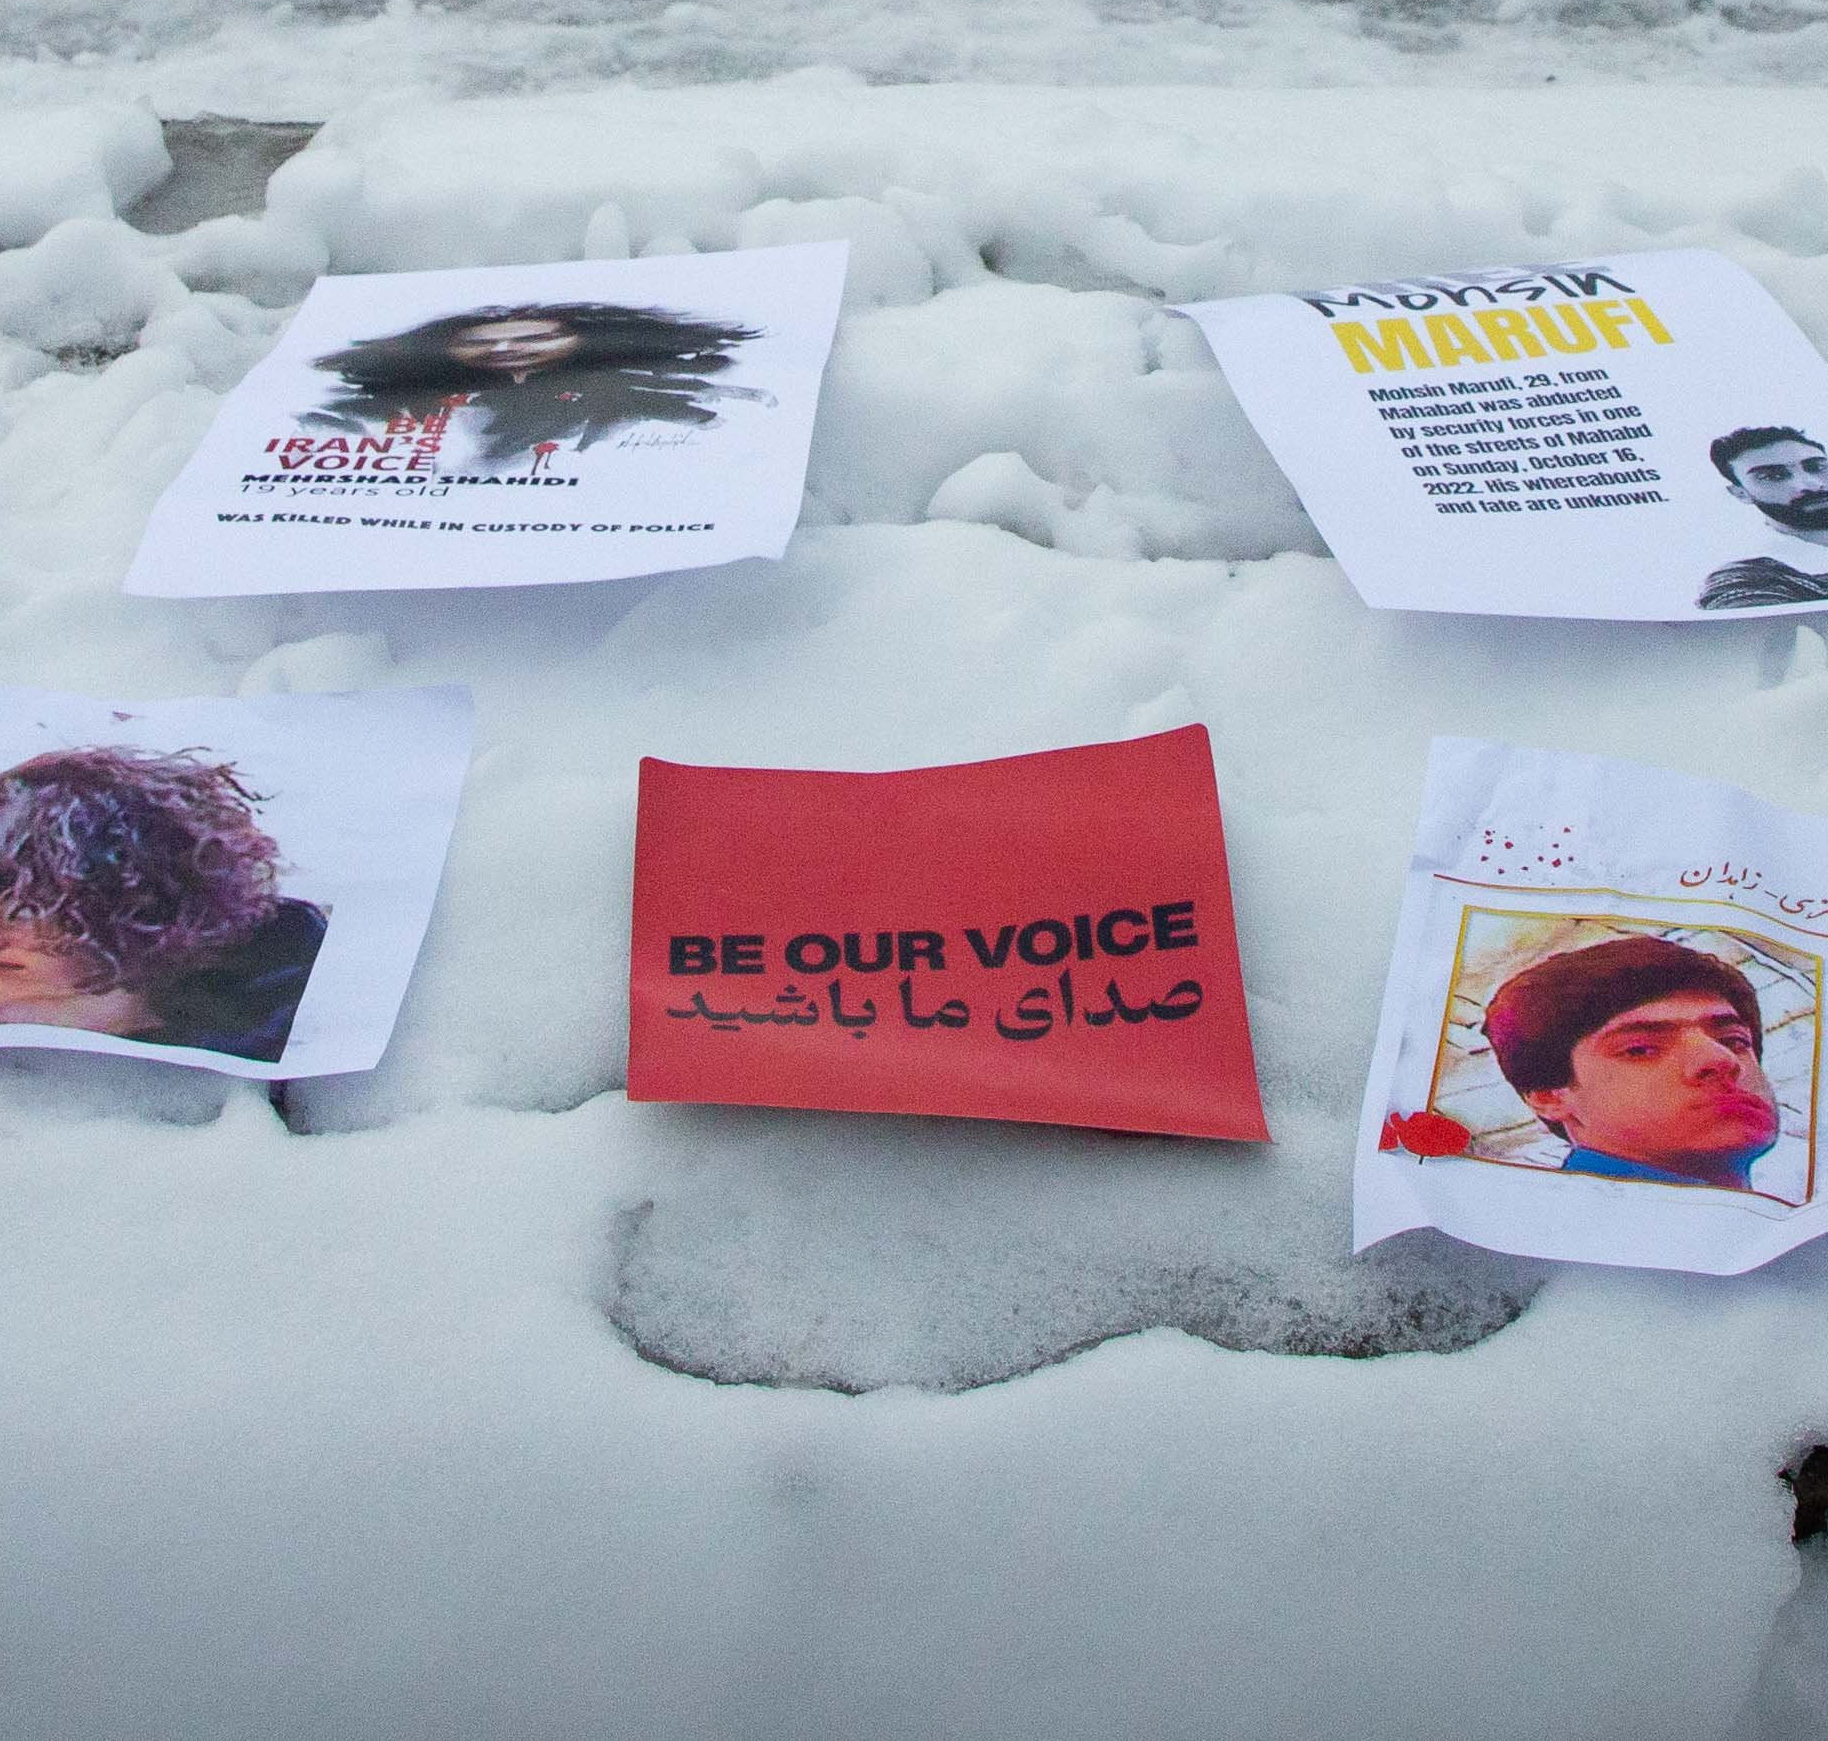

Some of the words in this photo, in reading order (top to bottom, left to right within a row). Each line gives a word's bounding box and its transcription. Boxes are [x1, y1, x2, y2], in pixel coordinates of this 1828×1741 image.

[1329, 297, 1676, 375] MARUFI
[1368, 383, 1447, 403] Mohsin
[1448, 376, 1523, 397] Marufi,
[1523, 373, 1558, 389] 29,
[1559, 367, 1610, 384] from
[1378, 401, 1476, 422] Mahabad
[1480, 398, 1522, 414] was
[1525, 385, 1623, 409] abducted
[385, 414, 449, 435] BE
[1389, 425, 1416, 441] by
[1420, 417, 1505, 438] security
[1507, 412, 1576, 430] forces
[1577, 408, 1599, 424] in
[1602, 403, 1643, 421] one
[1401, 445, 1423, 460] of
[1425, 440, 1461, 458] the
[1464, 435, 1542, 455] streets
[1543, 431, 1565, 448] of
[1566, 423, 1654, 446] Mahabd
[241, 474, 428, 485] MEHRSHAD
[437, 475, 579, 487] SHAHIDI
[278, 455, 435, 471] VOICE
[1412, 464, 1440, 478] on
[1442, 459, 1528, 476] Sunday,
[1529, 451, 1609, 471] October
[1612, 447, 1644, 464] 16,
[241, 484, 276, 494] 19
[286, 487, 379, 498] years
[395, 486, 450, 497] old
[1422, 481, 1483, 496] 2022.
[1484, 478, 1521, 494] His
[1522, 467, 1662, 491] whereabouts
[1434, 501, 1476, 515] and
[1477, 498, 1523, 513] fate
[1525, 496, 1562, 511] are
[1565, 489, 1670, 510] unknown.
[217, 513, 264, 522] WAS
[271, 513, 352, 525] KILLED
[360, 517, 432, 530] WHILE
[437, 521, 464, 531] IN
[471, 523, 585, 533] CUSTODY
[591, 523, 622, 532] OF
[629, 523, 715, 533] POLICE
[667, 933, 767, 977] BE
[783, 929, 948, 976] OUR
[962, 900, 1201, 970] VOICE
[666, 978, 878, 1040] باشید
[899, 977, 971, 1030] ما
[993, 970, 1204, 1042] صدای
